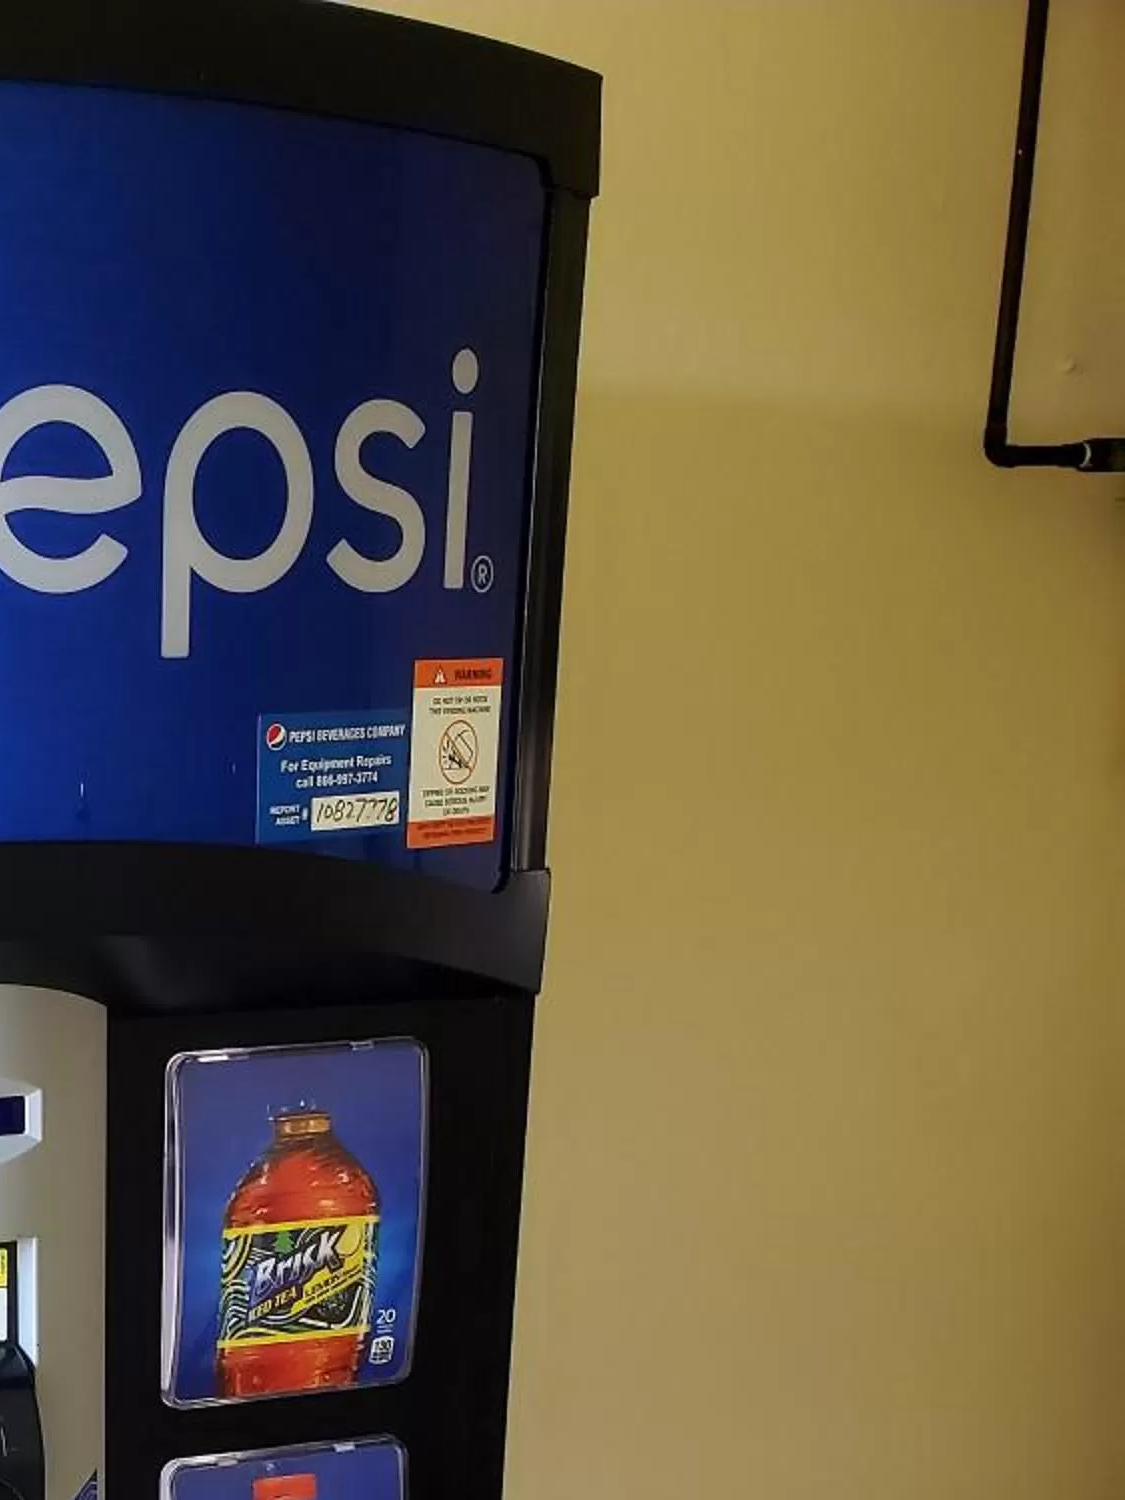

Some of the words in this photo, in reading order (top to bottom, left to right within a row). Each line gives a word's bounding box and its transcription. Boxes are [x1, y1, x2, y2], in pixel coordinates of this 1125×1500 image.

[289, 730, 315, 743] PEPSI
[317, 727, 366, 742] BEVERAGES
[367, 724, 406, 738] COMPANY
[280, 760, 299, 773] For
[301, 756, 354, 773] Equipment
[356, 754, 392, 769] Repairs
[295, 775, 314, 788] call
[376, 1309, 396, 1324] 20
